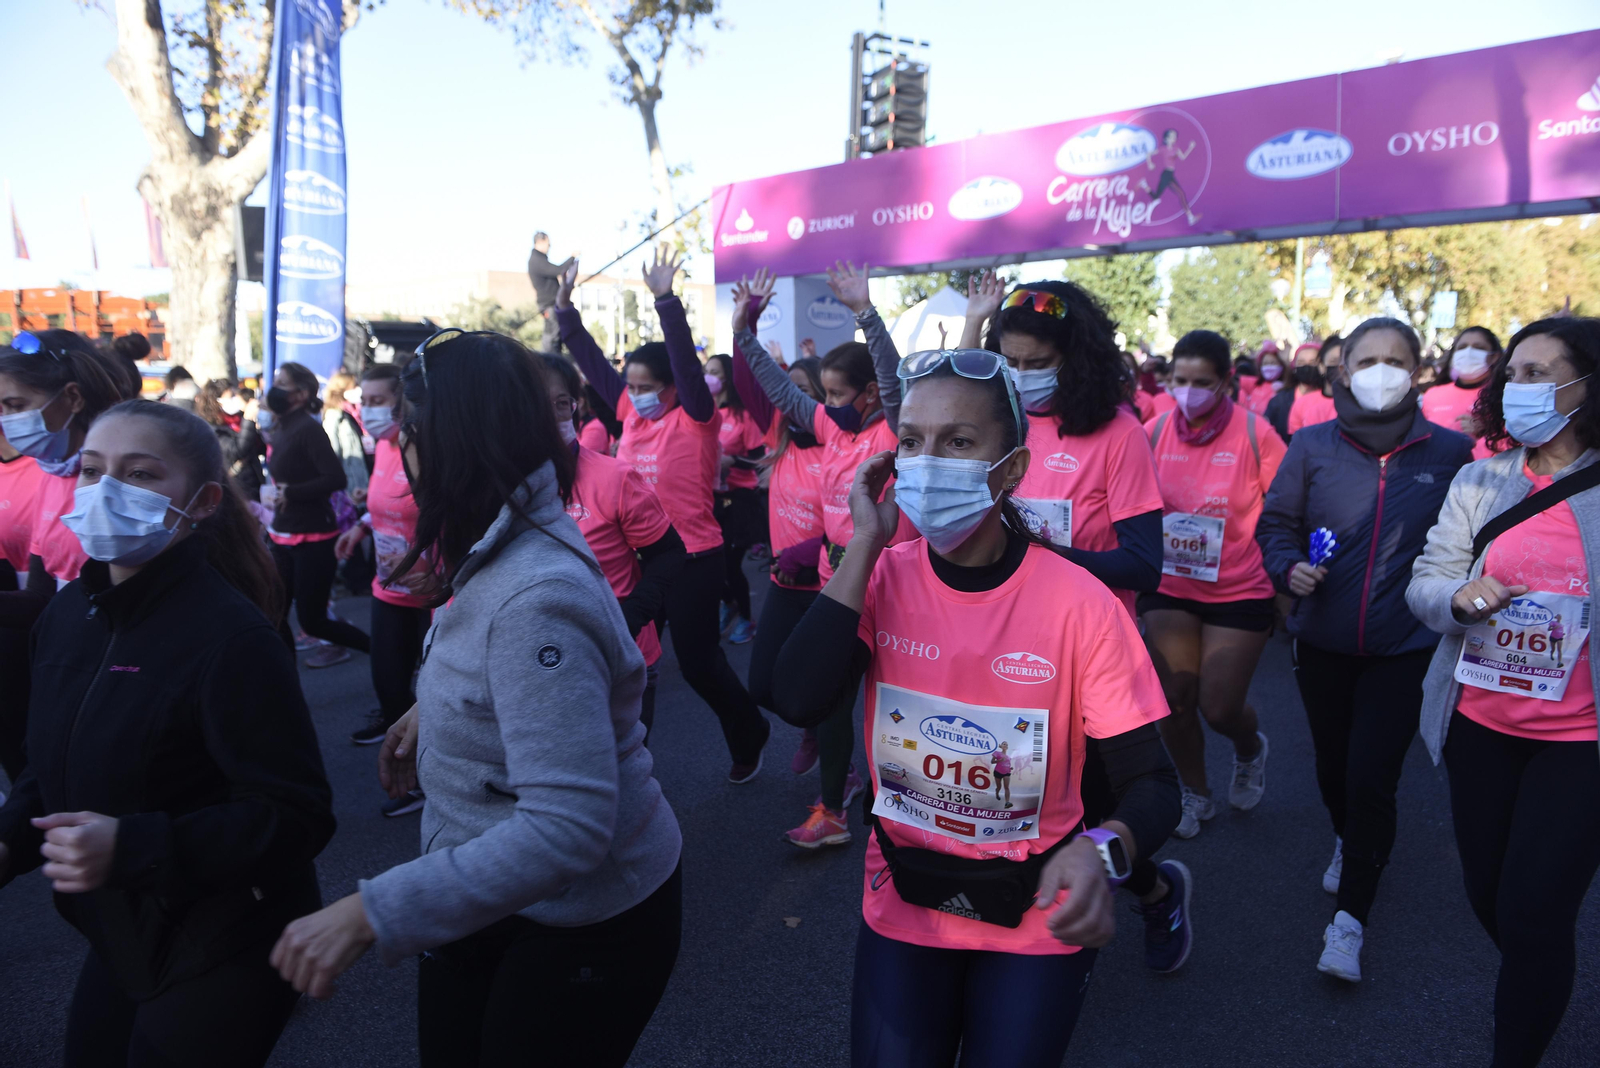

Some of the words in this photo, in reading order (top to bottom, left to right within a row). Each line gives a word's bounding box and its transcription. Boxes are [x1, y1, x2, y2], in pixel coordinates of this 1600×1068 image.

[1387, 121, 1500, 156] OYSHO
[1047, 175, 1130, 205] Carrera
[872, 201, 935, 226] OYSHO
[1066, 203, 1083, 222] de
[1084, 200, 1097, 220] la
[1094, 192, 1161, 238] Mujer
[808, 214, 854, 234] ZURICH
[721, 230, 769, 247] Santander
[637, 454, 657, 462] POR
[1205, 496, 1229, 505] POR
[1171, 538, 1199, 552] 016
[1569, 577, 1591, 594] PO
[876, 630, 941, 661] OYSHO
[1496, 628, 1547, 653] 016
[1479, 658, 1508, 671] CARRERA
[1510, 664, 1521, 673] DE
[1521, 666, 1533, 676] LA
[1533, 668, 1562, 678] MUJER
[1506, 653, 1527, 665] 604
[996, 660, 1051, 678] ASTURIANA
[1461, 667, 1495, 683] OYSHO
[925, 722, 991, 750] ASTURIANA
[936, 723, 961, 733] CENTRAL
[922, 753, 991, 790] 016
[906, 789, 945, 810] CARRERA
[946, 803, 960, 814] DE
[961, 806, 975, 817] LA
[976, 809, 1012, 820] MUJER
[937, 787, 972, 805] 3136
[884, 796, 929, 821] OYSHO
[998, 825, 1020, 835] ZURI
[938, 904, 982, 921] adidas
